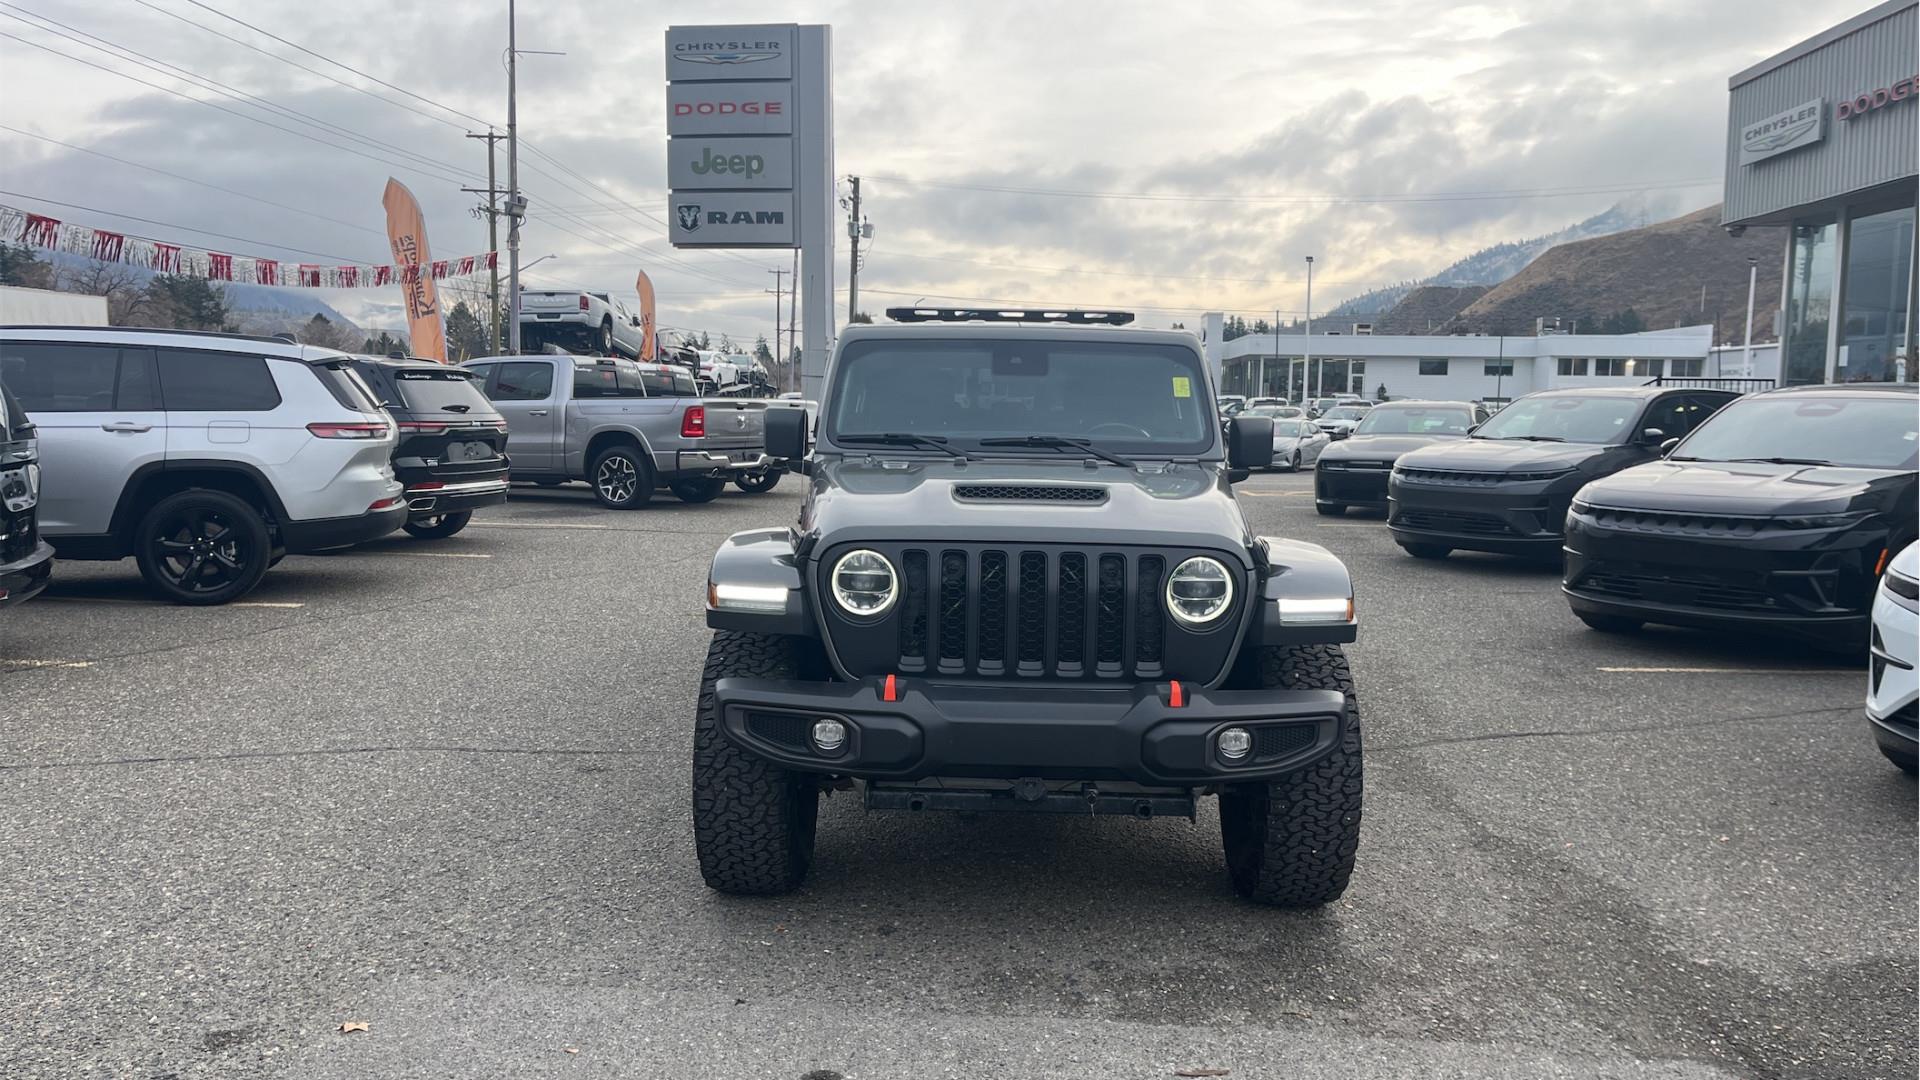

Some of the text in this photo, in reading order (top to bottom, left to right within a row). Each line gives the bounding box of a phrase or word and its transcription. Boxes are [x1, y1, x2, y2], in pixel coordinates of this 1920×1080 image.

[675, 41, 781, 51] CHRYSLER
[674, 101, 783, 116] DODGE
[1744, 106, 1817, 141] CHRYSLER
[690, 147, 765, 179] Jeep
[706, 210, 784, 225] RAM
